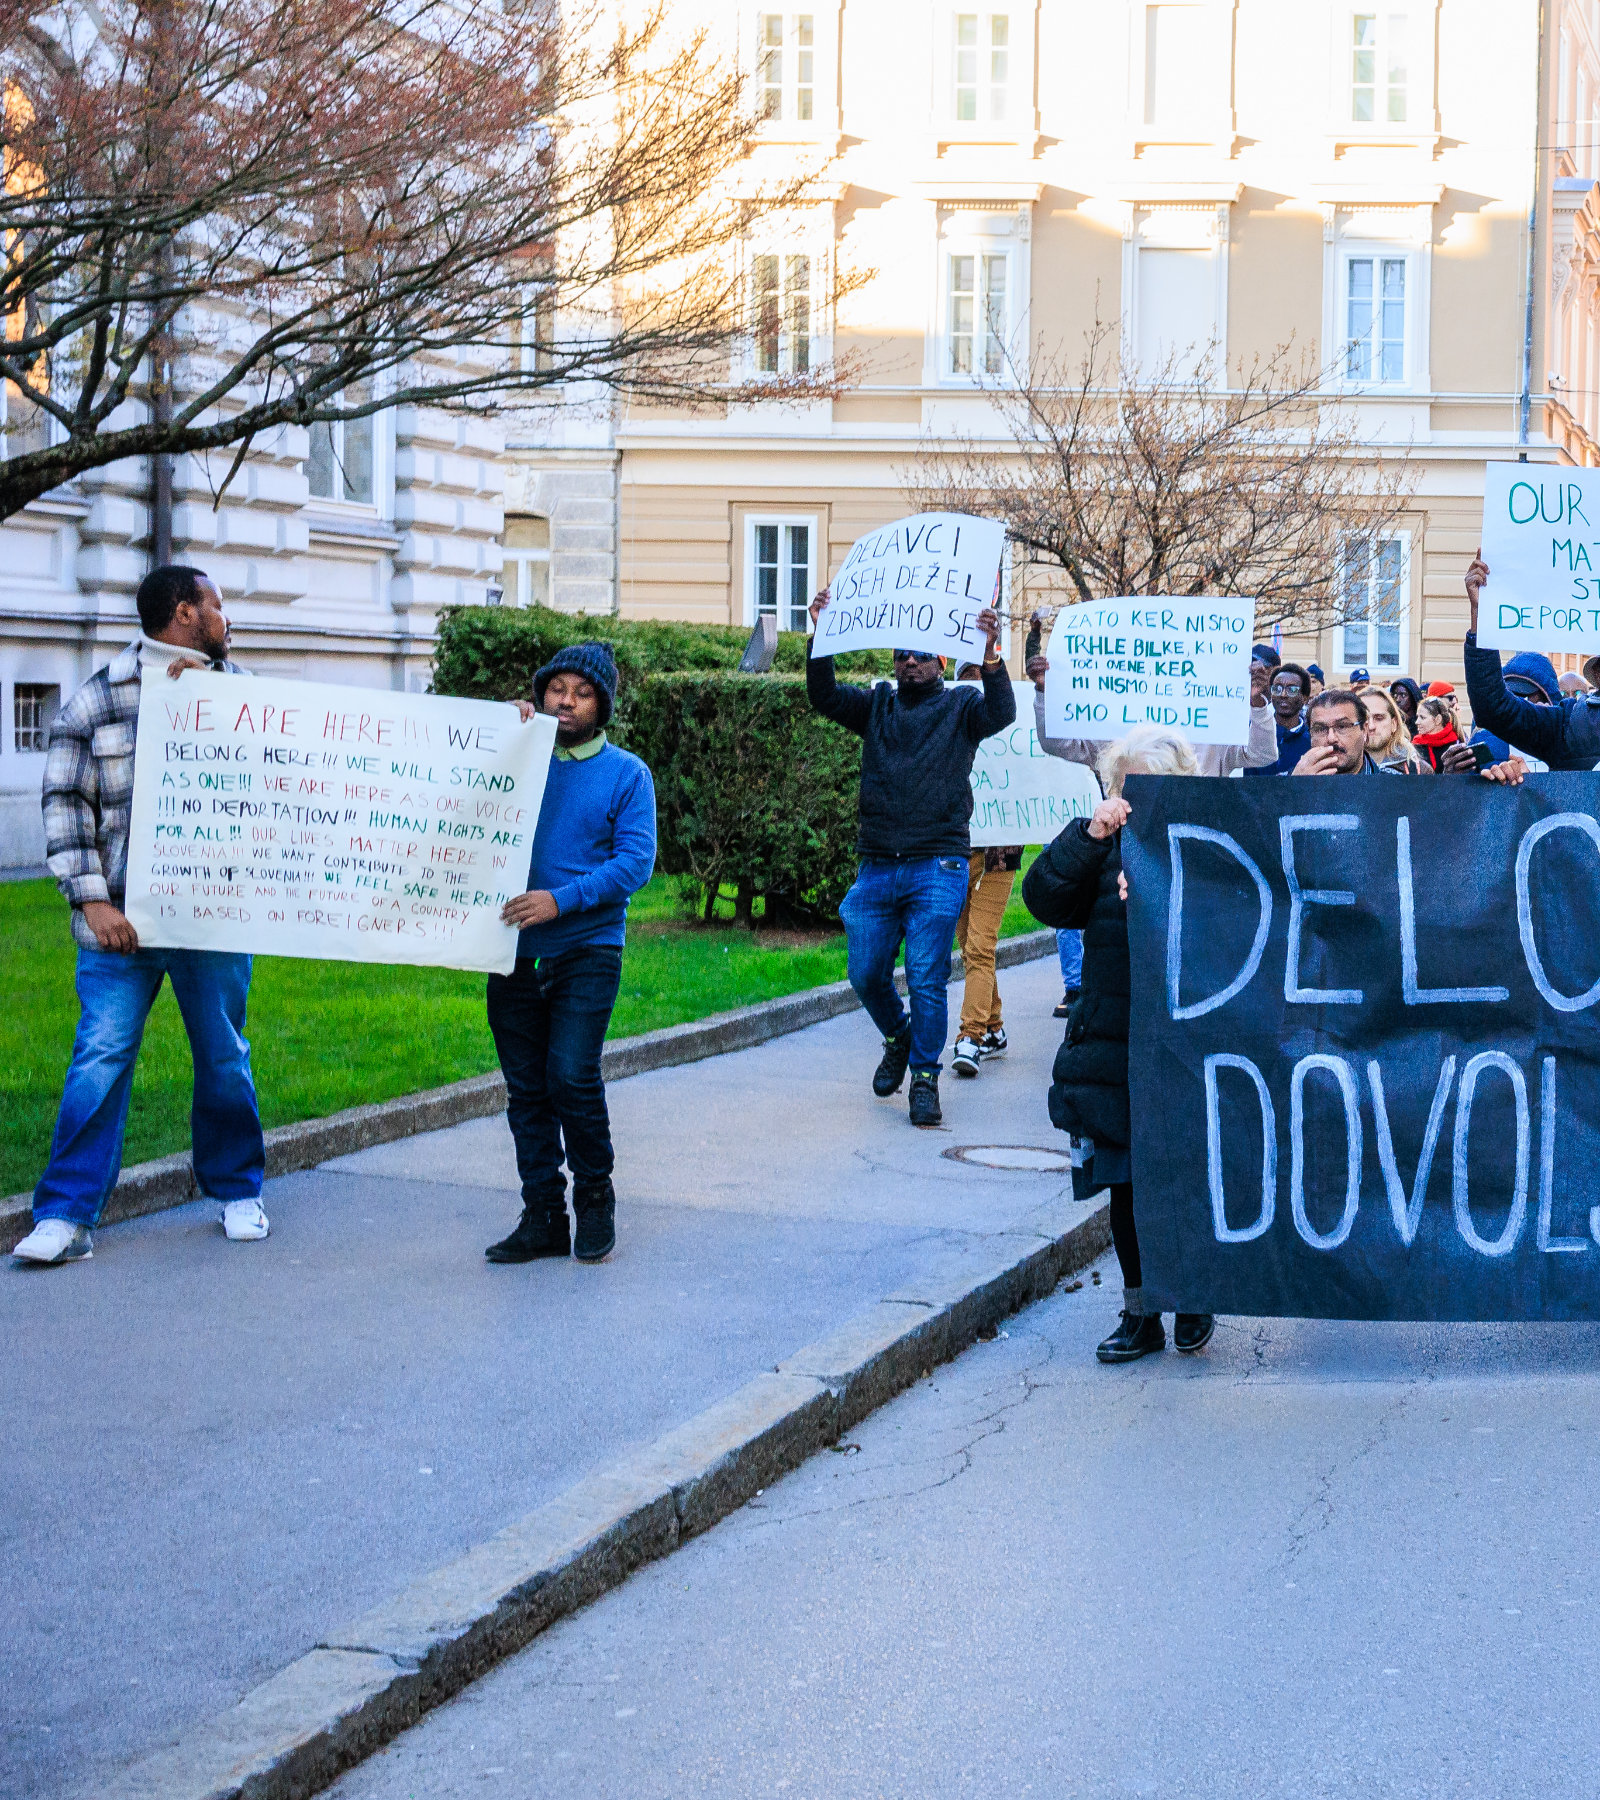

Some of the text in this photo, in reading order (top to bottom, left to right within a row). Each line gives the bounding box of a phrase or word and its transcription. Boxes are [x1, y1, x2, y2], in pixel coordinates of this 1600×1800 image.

[1508, 481, 1590, 527] OUR
[846, 523, 961, 570] DELAVCI
[836, 562, 982, 602] VSEH DEŽEL
[825, 599, 977, 645] ZDRUŽIMO SE
[1067, 609, 1245, 633] ZATO KER NISMO
[1064, 634, 1127, 655] TRHLE
[1195, 640, 1213, 656] KI
[1222, 641, 1238, 655] PO
[1071, 657, 1098, 670] TOČI
[1155, 660, 1197, 679] KER
[1072, 676, 1089, 689] MI
[1099, 676, 1148, 695] NISMO
[1155, 682, 1173, 697] LE
[165, 699, 215, 732] WE
[233, 703, 301, 737] ARE
[448, 724, 500, 753] WE
[1064, 703, 1109, 722] SMO
[165, 741, 248, 763] BELONG
[346, 754, 381, 775] WE
[391, 761, 438, 784] WILL
[450, 766, 515, 793] STAND
[162, 771, 191, 788] AS
[264, 775, 292, 792] WE
[299, 777, 335, 797] ARE
[344, 781, 394, 804] HERE
[400, 793, 429, 808] AS
[436, 796, 465, 814] ONE
[475, 800, 528, 825] VOICE
[182, 798, 202, 815] NO
[369, 810, 428, 834] HUMAN
[438, 819, 485, 840] RIGHTS
[491, 830, 524, 848] ARE
[156, 824, 187, 839] FOR
[252, 826, 282, 844] OUR
[290, 829, 335, 847] LIVES
[350, 836, 418, 858] MATTER
[430, 845, 479, 866] HERE
[492, 854, 507, 869] IN
[252, 847, 272, 860] WE
[281, 848, 316, 863] WANT
[324, 854, 409, 876] CONTRIBUTE
[421, 866, 435, 880] TO
[443, 870, 470, 885] THE
[151, 863, 212, 879] GROWTH
[219, 866, 239, 881] OF
[324, 871, 342, 884] WE
[355, 873, 393, 892] FEEL
[404, 883, 439, 898] SAFE
[150, 882, 470, 925] OUR FUTURE AND THE FUTURE OF A COUNTRY
[160, 905, 177, 918] IS
[193, 905, 251, 923] BASED
[268, 909, 284, 922] ON
